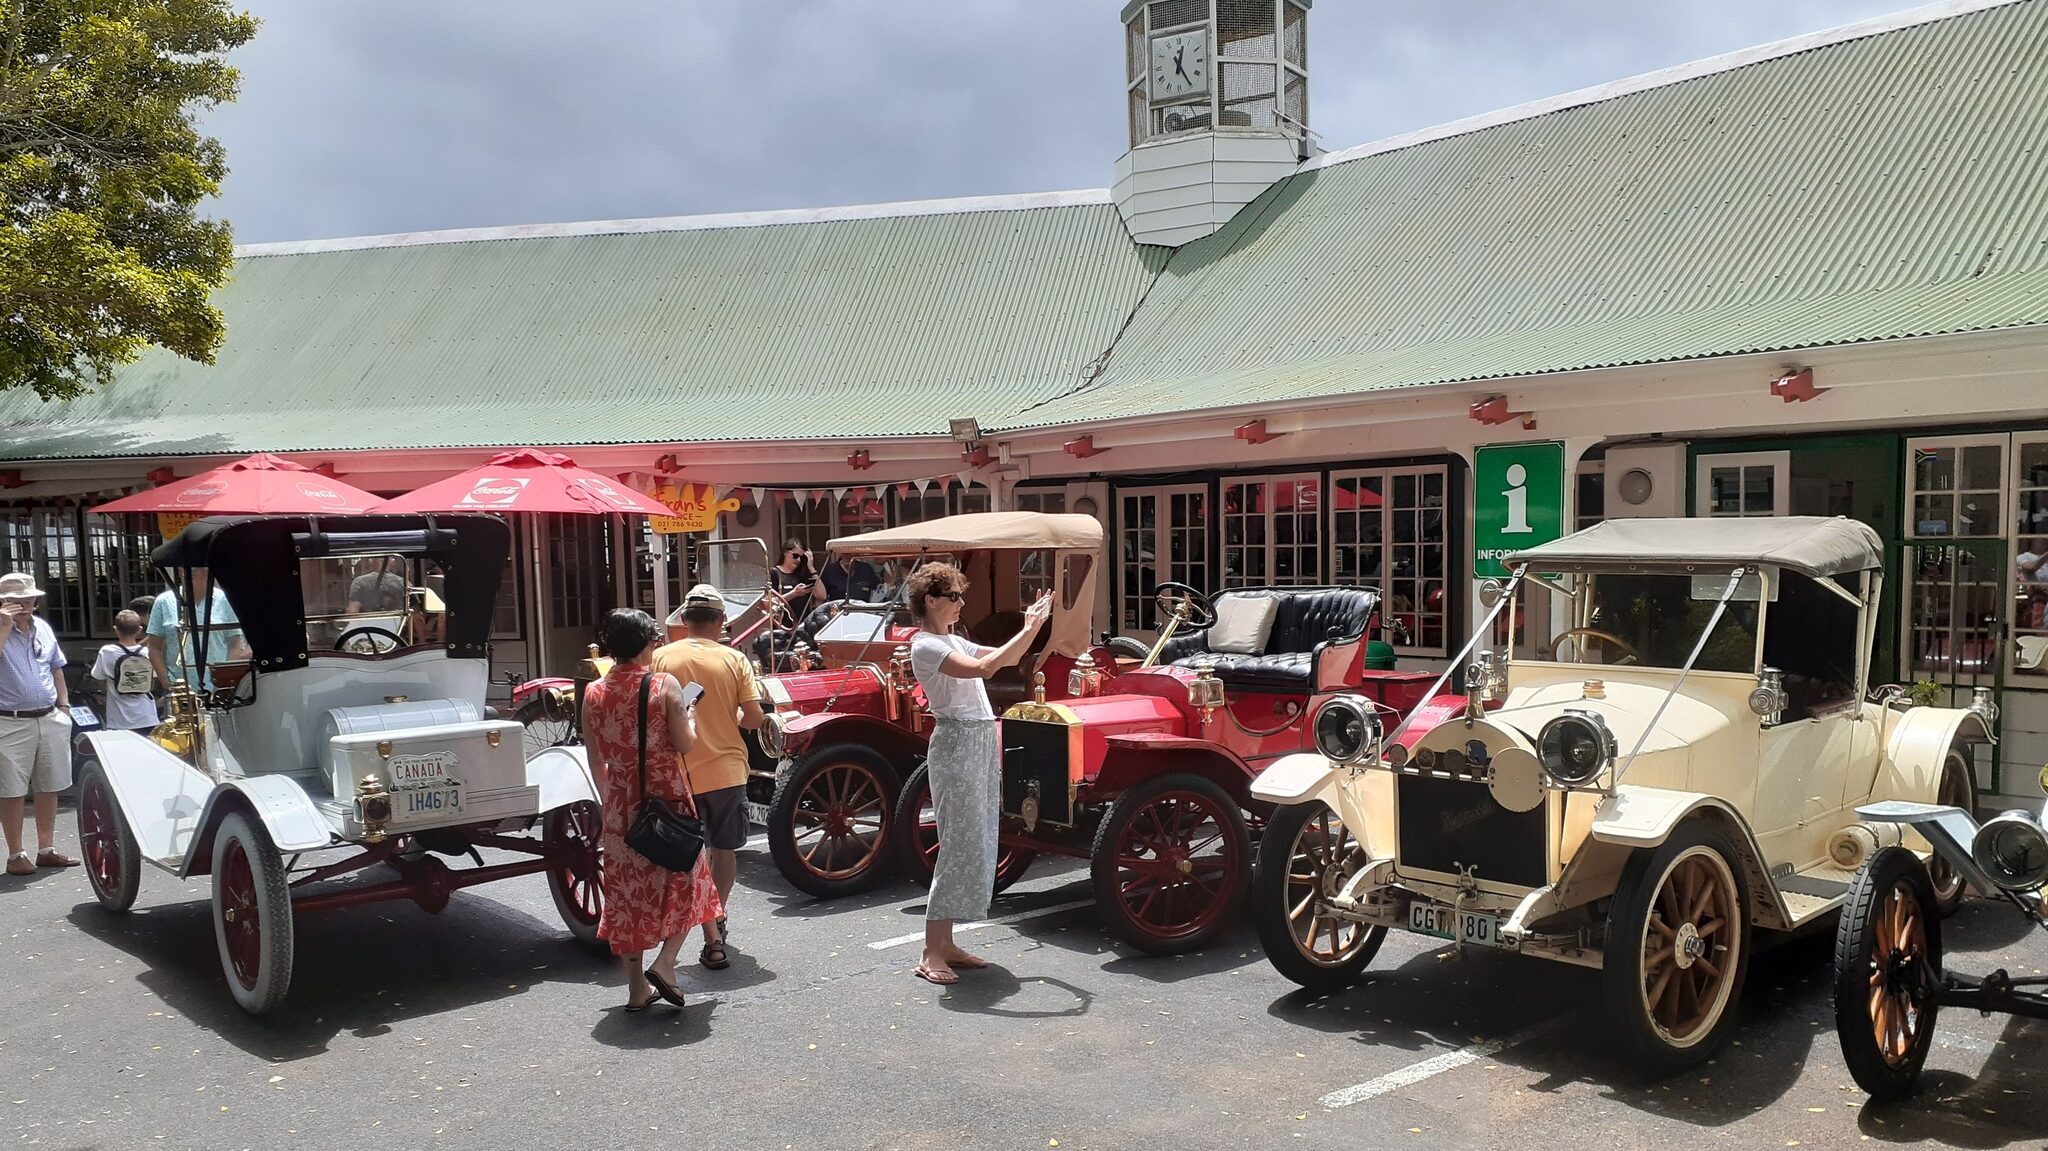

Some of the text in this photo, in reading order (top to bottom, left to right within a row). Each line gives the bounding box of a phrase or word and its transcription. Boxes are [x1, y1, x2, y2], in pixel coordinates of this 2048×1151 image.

[1477, 548, 1524, 560] INFO
[395, 762, 443, 780] CANADA
[408, 789, 459, 812] 1H4673
